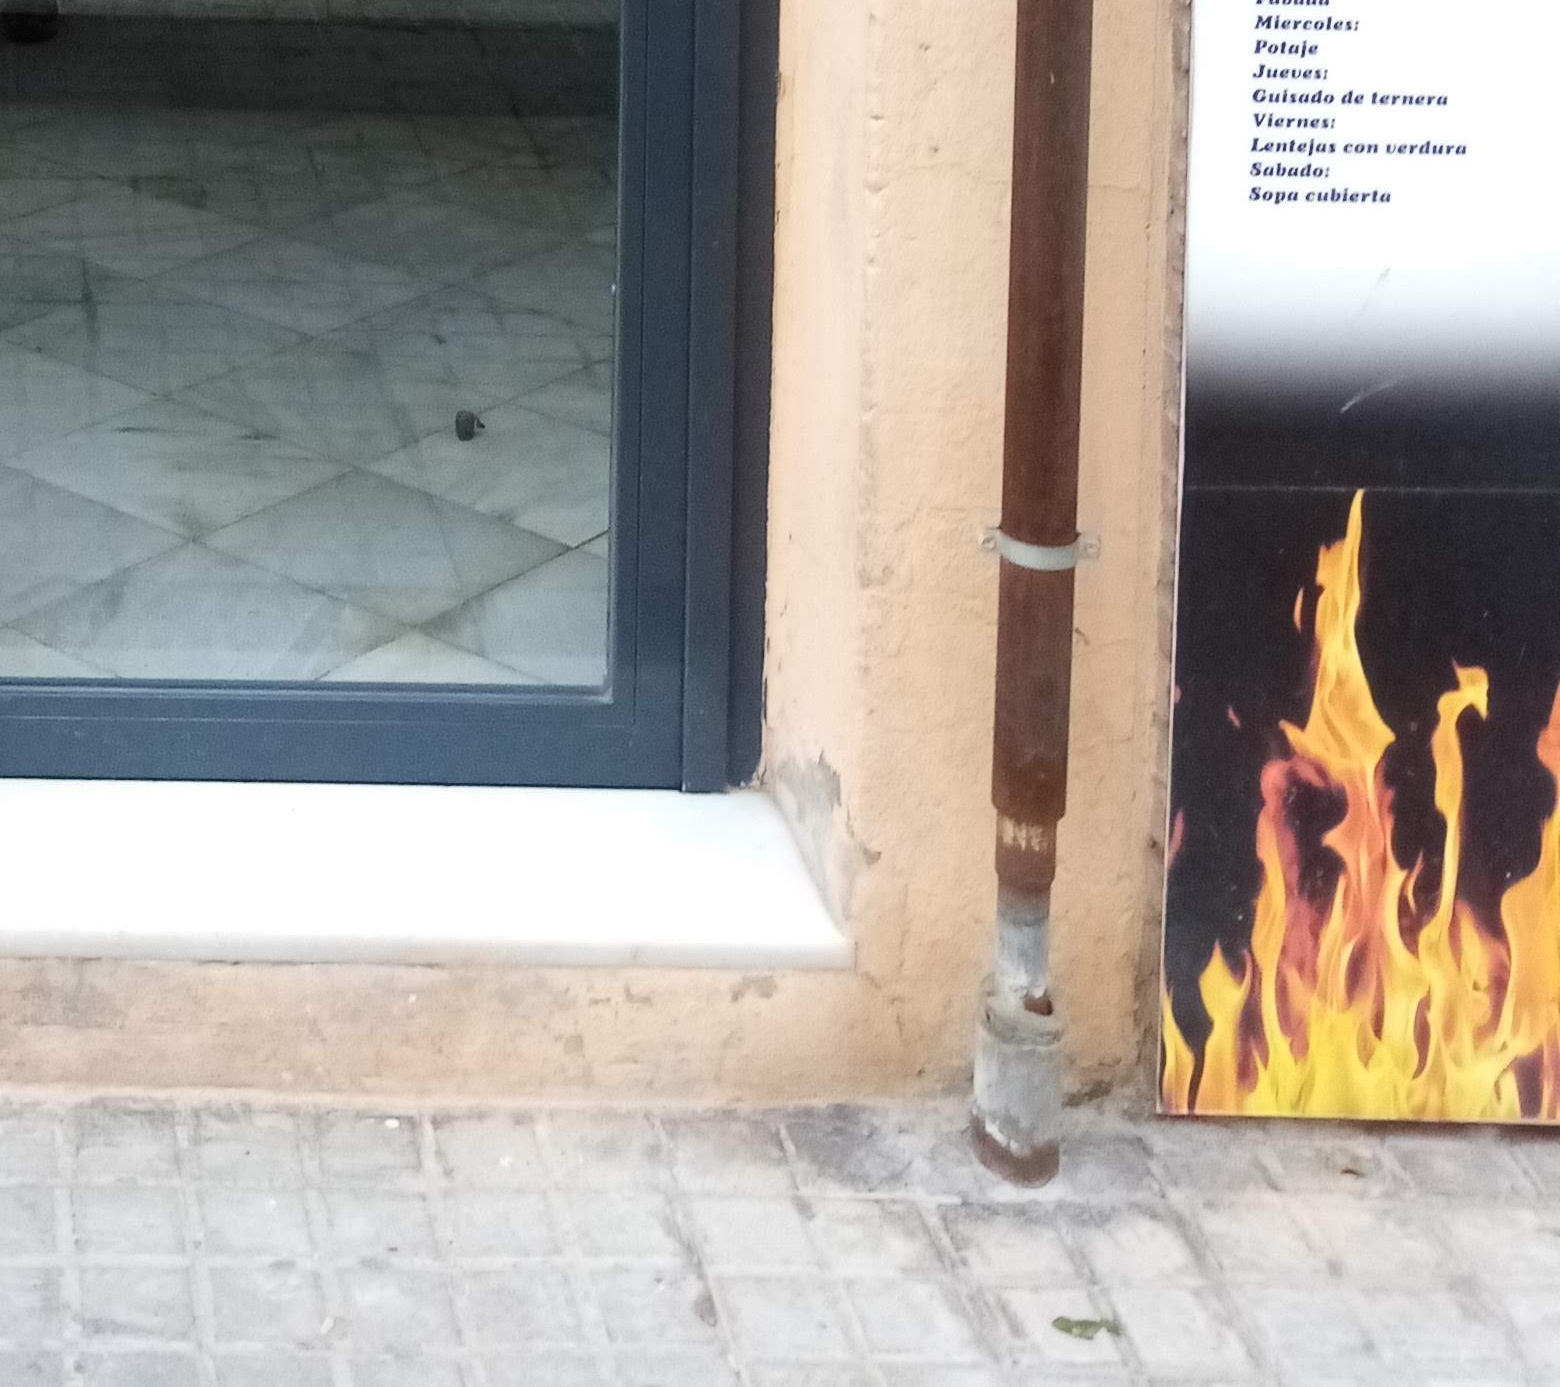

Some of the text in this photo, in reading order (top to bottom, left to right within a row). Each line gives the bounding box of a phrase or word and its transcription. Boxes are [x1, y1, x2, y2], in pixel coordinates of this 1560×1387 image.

[1253, 39, 1319, 59] Potaje
[1251, 88, 1449, 107] Guisado de ternera
[1250, 137, 1467, 157] Lentejas con verdura
[1248, 186, 1392, 206] Sopa cubierta
